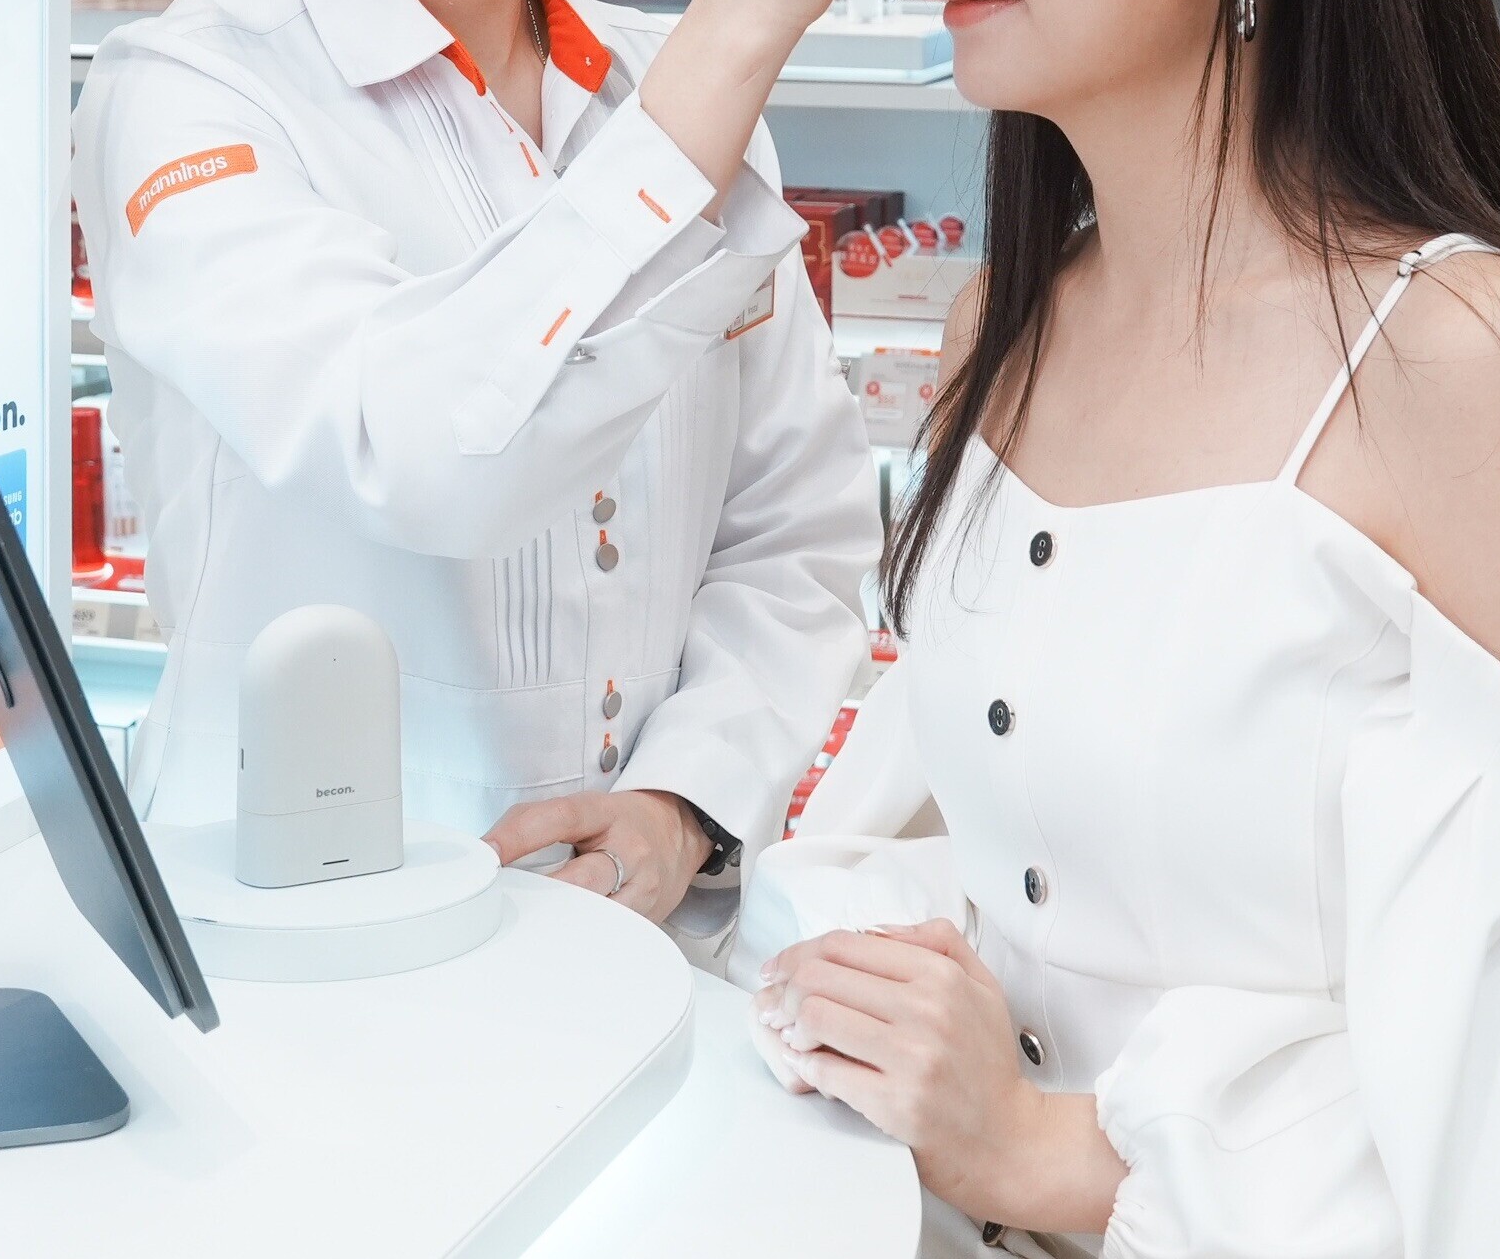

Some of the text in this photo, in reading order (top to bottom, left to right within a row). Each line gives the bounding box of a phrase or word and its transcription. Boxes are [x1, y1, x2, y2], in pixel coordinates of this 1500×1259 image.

[139, 155, 228, 211] mannings
[3, 490, 23, 505] SUNG
[316, 785, 356, 798] becon.
